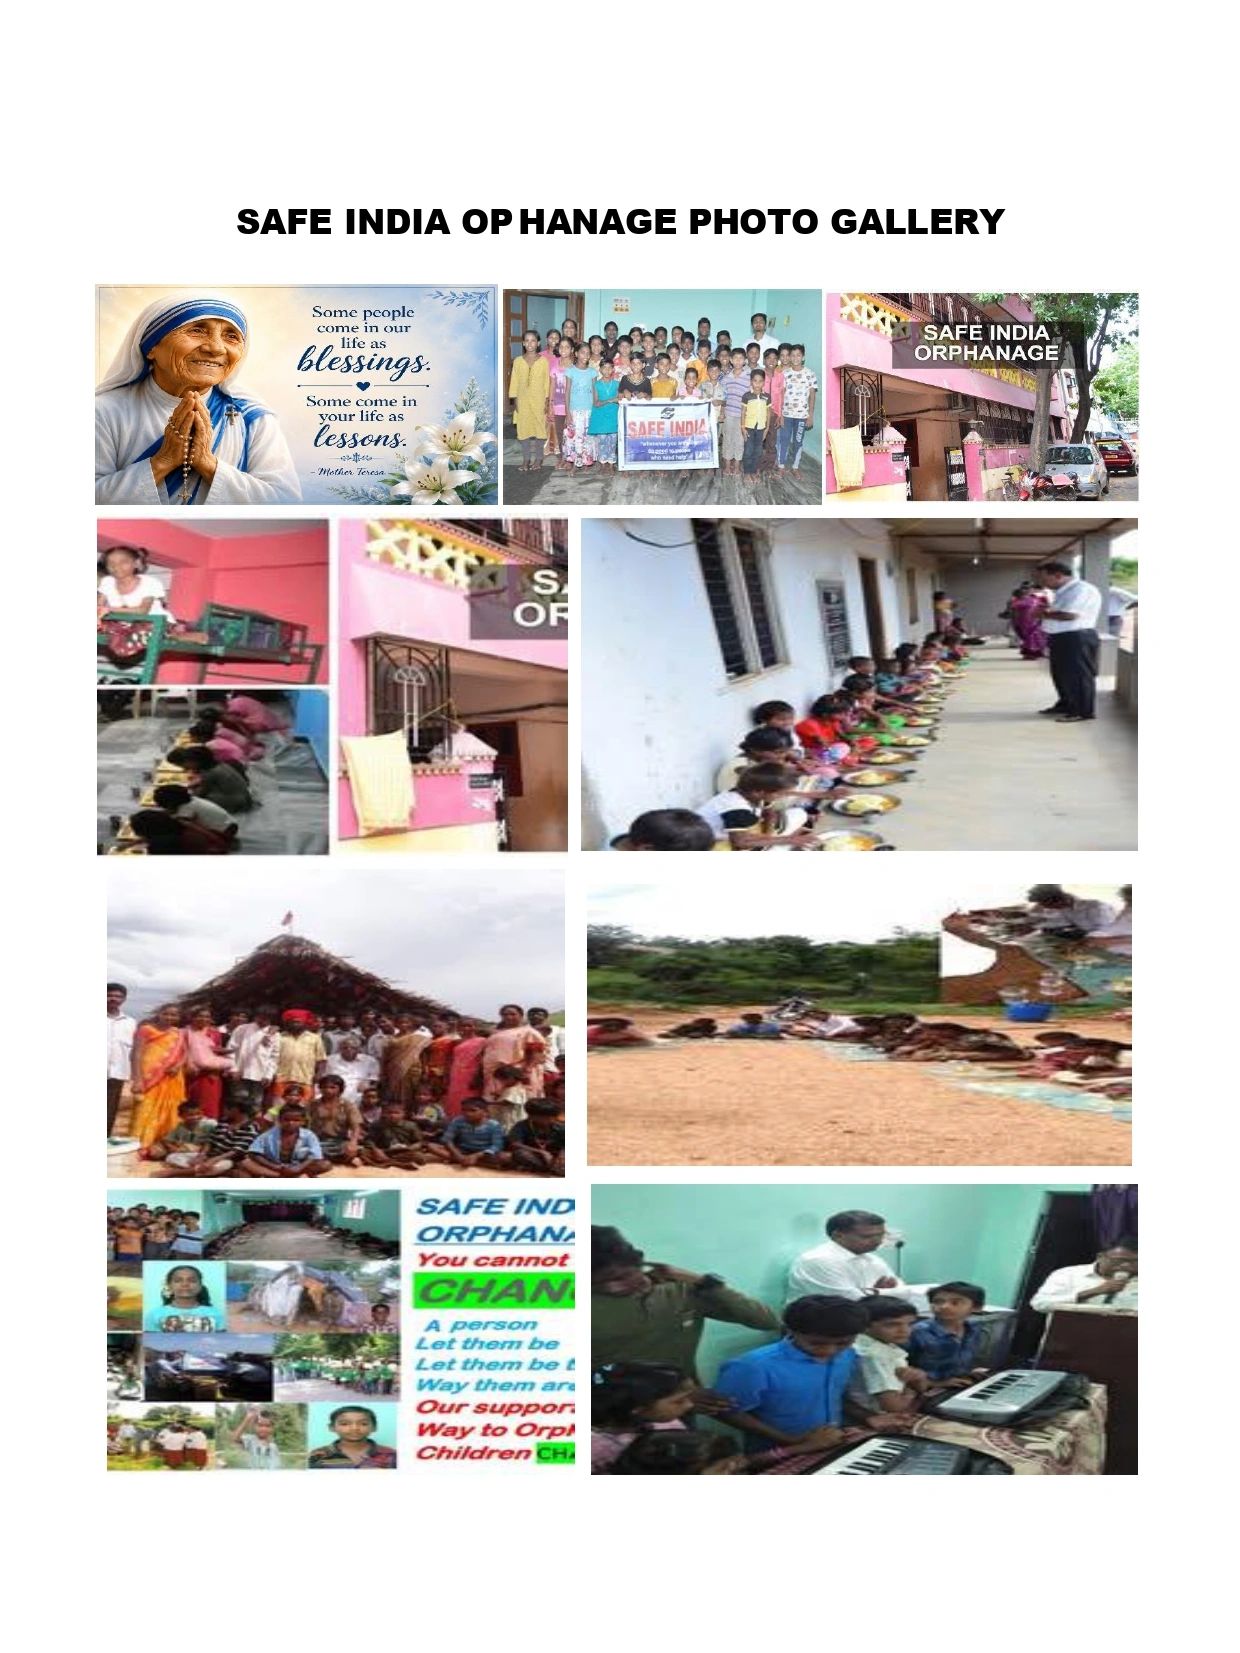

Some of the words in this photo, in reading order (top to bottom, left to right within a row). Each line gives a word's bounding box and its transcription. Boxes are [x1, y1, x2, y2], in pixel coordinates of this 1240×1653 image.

[312, 305, 358, 318] Some
[363, 305, 414, 321] people
[317, 325, 359, 333] come
[364, 321, 379, 333] in
[384, 325, 411, 333] our
[340, 336, 366, 349] life
[370, 340, 387, 349] as
[296, 344, 431, 382] blessings.
[306, 395, 351, 407] Some
[355, 398, 398, 407] come
[402, 395, 417, 407] in
[318, 413, 355, 425] your
[360, 410, 385, 422] life
[388, 413, 404, 422] as
[628, 420, 665, 438] SAFE
[670, 417, 706, 437] INDIA
[313, 424, 407, 449] lessons.
[317, 467, 354, 477] Mother
[357, 467, 386, 476] Teresa
[416, 1198, 509, 1215] SAFE
[514, 1198, 575, 1215] IND
[418, 1252, 468, 1267] You
[473, 1253, 570, 1267] cannot
[420, 1278, 575, 1303] CHAN
[424, 1319, 441, 1332] A
[449, 1320, 539, 1333] person
[415, 1337, 457, 1350] Let
[461, 1337, 523, 1350] them
[528, 1337, 560, 1350] be
[415, 1358, 457, 1371] Let
[461, 1358, 523, 1371] them
[528, 1358, 560, 1371] be
[417, 1378, 469, 1394] Way
[474, 1379, 536, 1392] them
[416, 1400, 469, 1414] Our
[417, 1423, 476, 1440] Way
[481, 1423, 508, 1437] to
[416, 1445, 532, 1460] Children
